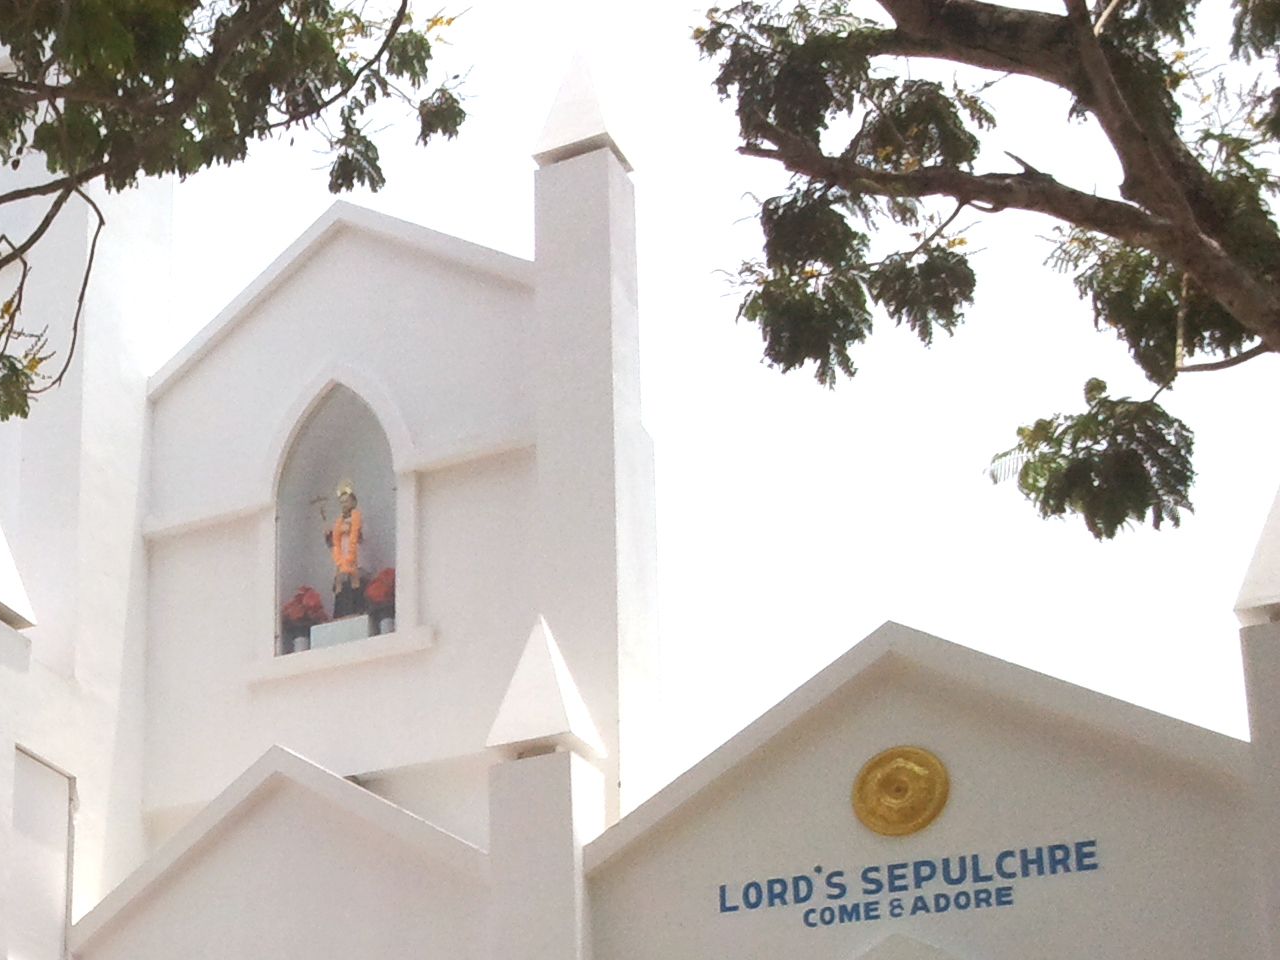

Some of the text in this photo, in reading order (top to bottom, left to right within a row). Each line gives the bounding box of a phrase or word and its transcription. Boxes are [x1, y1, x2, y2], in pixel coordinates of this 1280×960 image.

[719, 840, 1098, 913] LORD'S SEPULCHRE
[802, 901, 881, 928] COME
[910, 886, 1014, 915] ADORE
